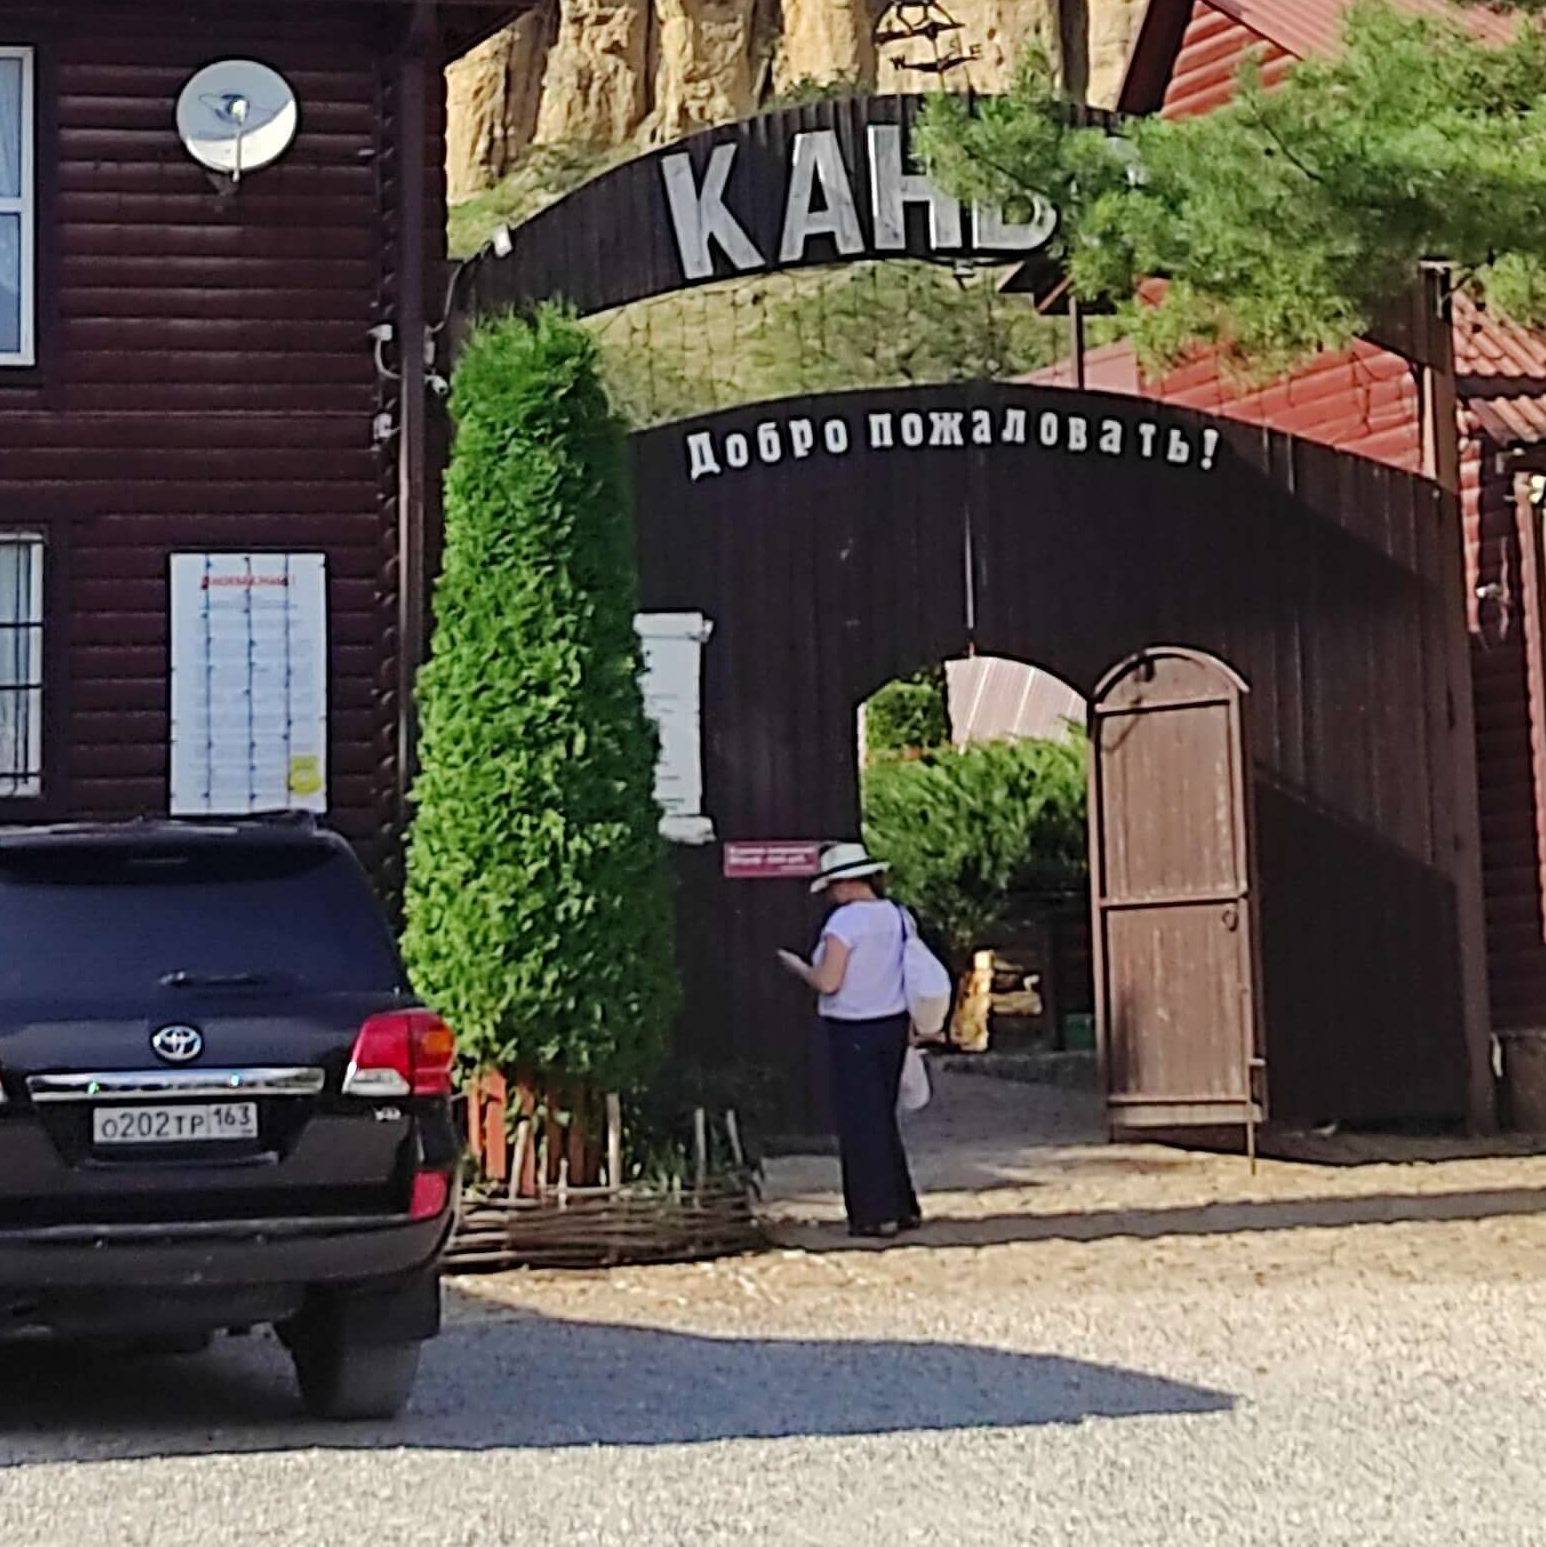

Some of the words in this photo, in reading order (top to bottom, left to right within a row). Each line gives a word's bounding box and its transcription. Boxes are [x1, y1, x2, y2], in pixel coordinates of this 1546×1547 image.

[660, 123, 1153, 281] КАНЬ
[686, 418, 849, 480] Добро
[869, 407, 1220, 471] пожаловать!
[212, 1104, 252, 1127] 163
